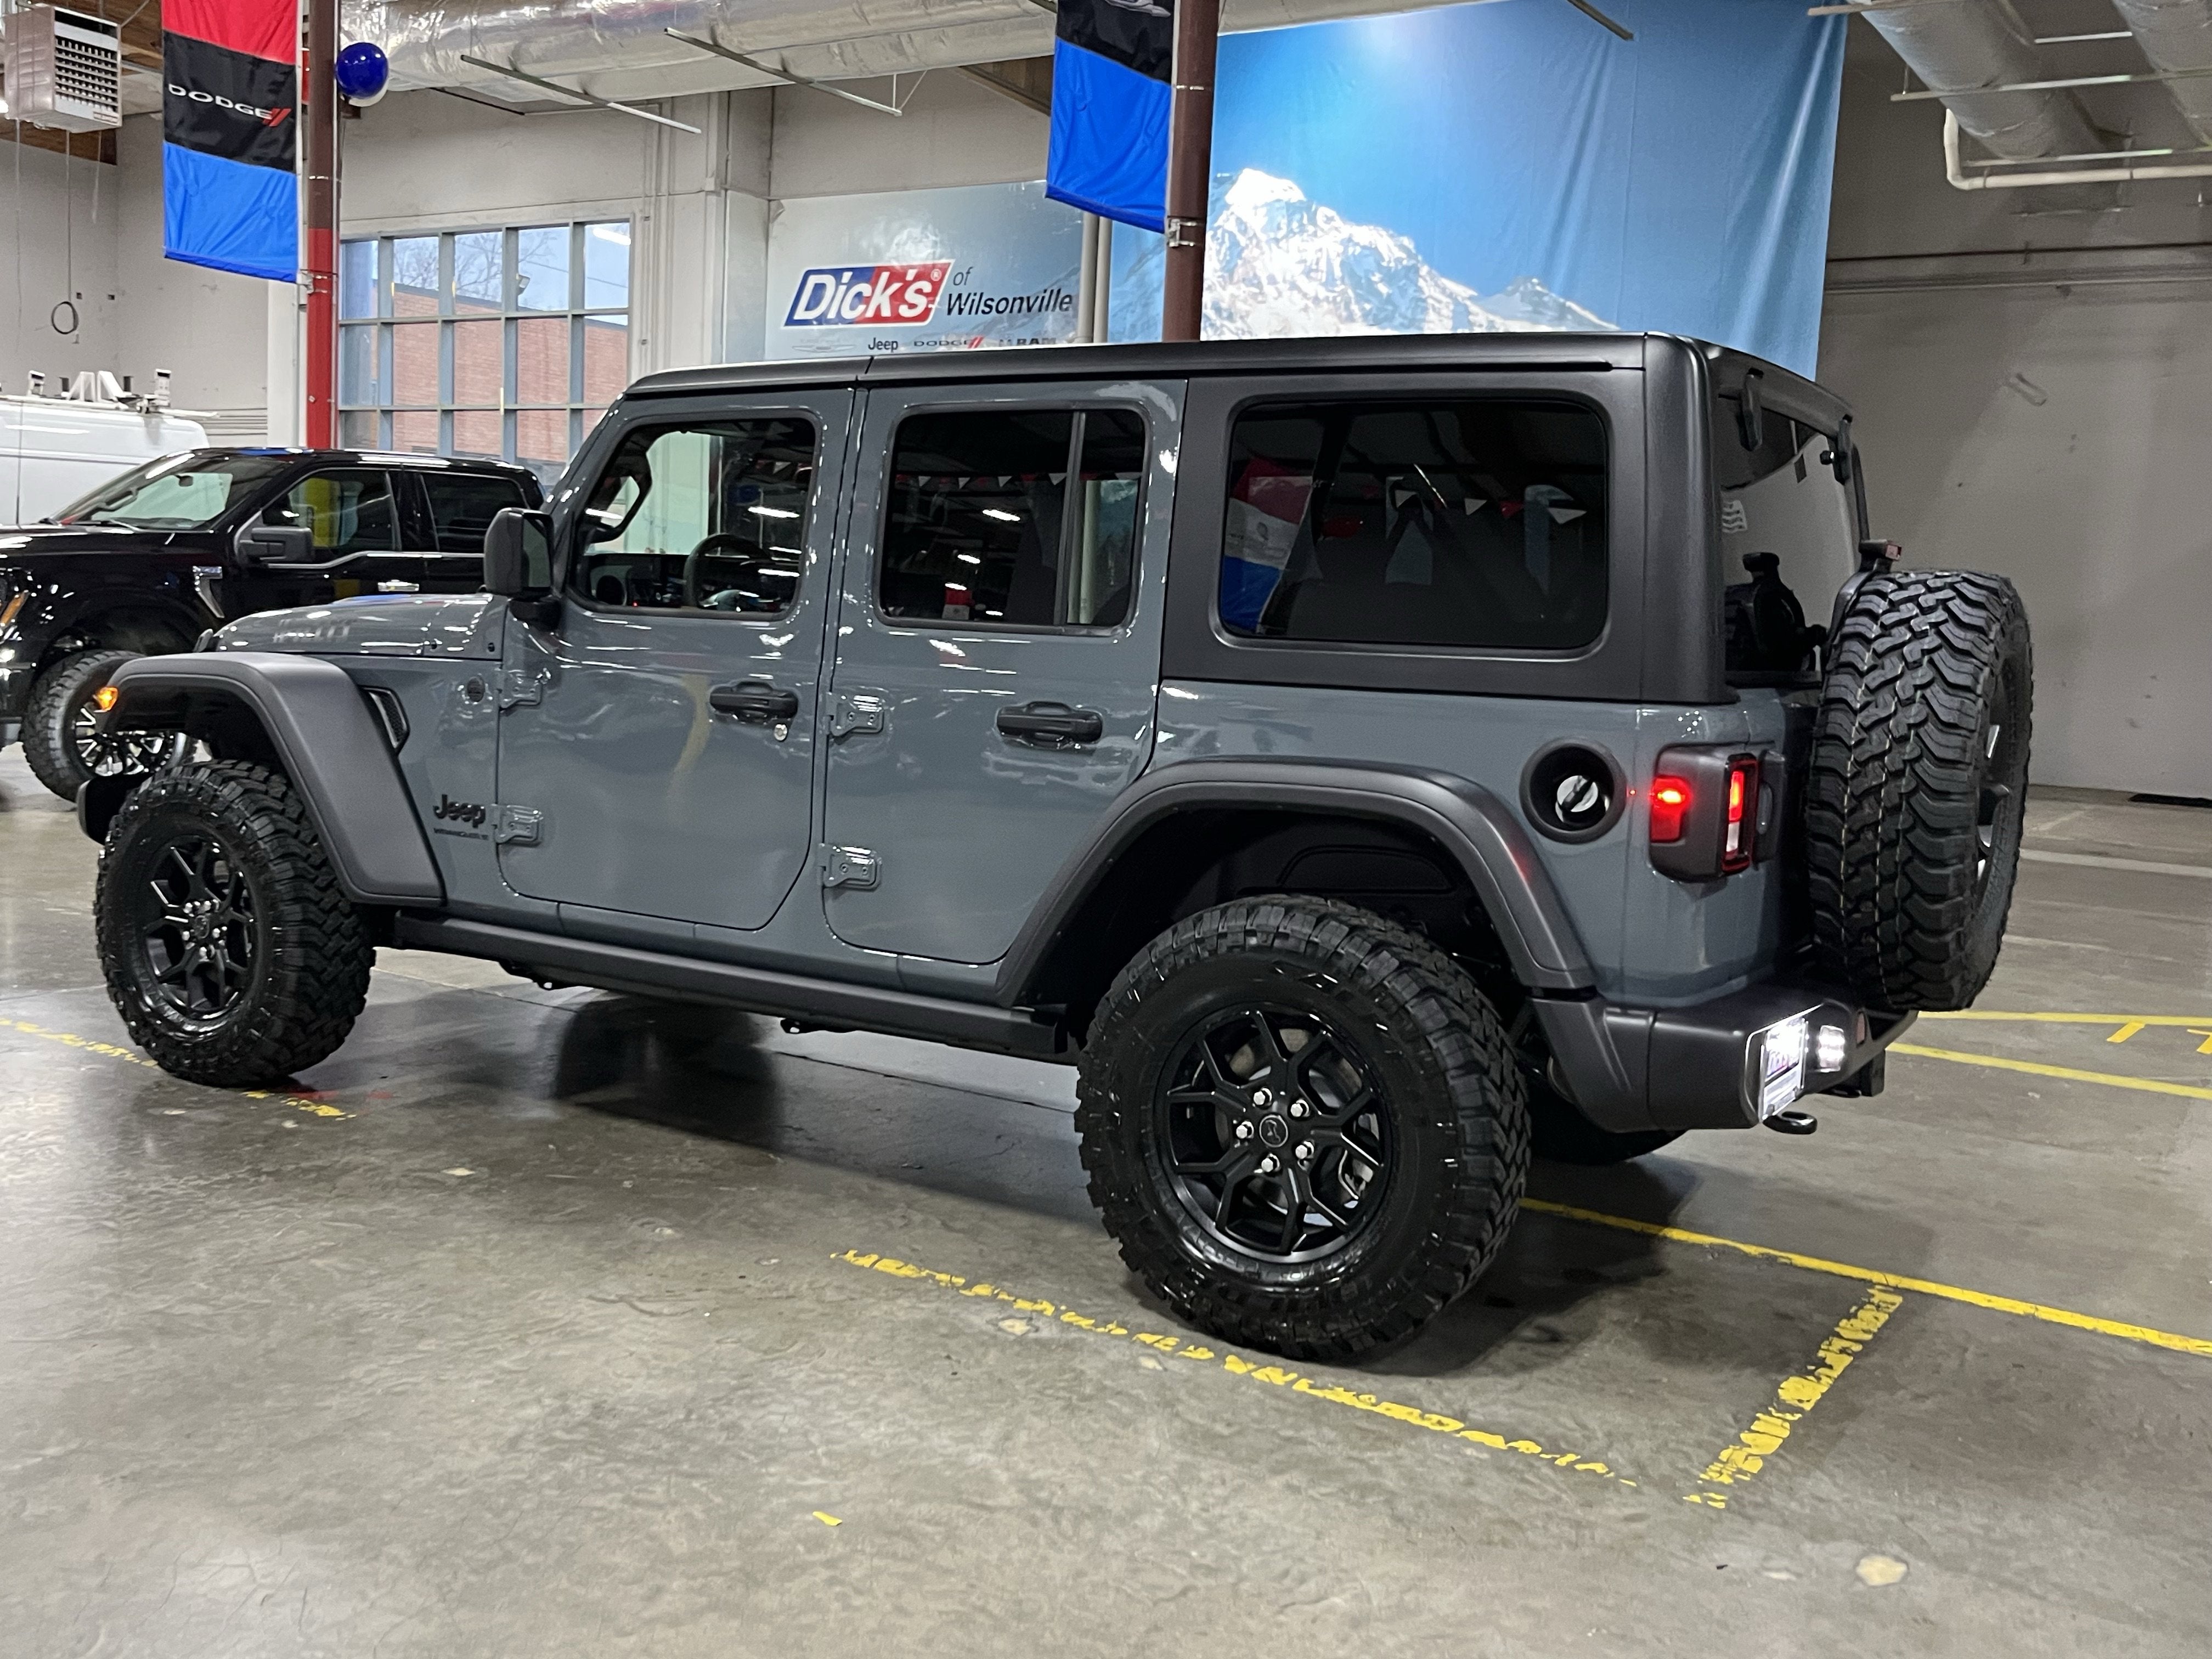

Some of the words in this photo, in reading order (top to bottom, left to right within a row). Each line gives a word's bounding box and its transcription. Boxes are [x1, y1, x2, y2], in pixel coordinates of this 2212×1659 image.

[168, 83, 273, 120] DODGE
[953, 266, 973, 286] of
[947, 288, 1073, 315] Wilsonville
[868, 337, 898, 352] Jeep
[433, 794, 486, 828] Jeep
